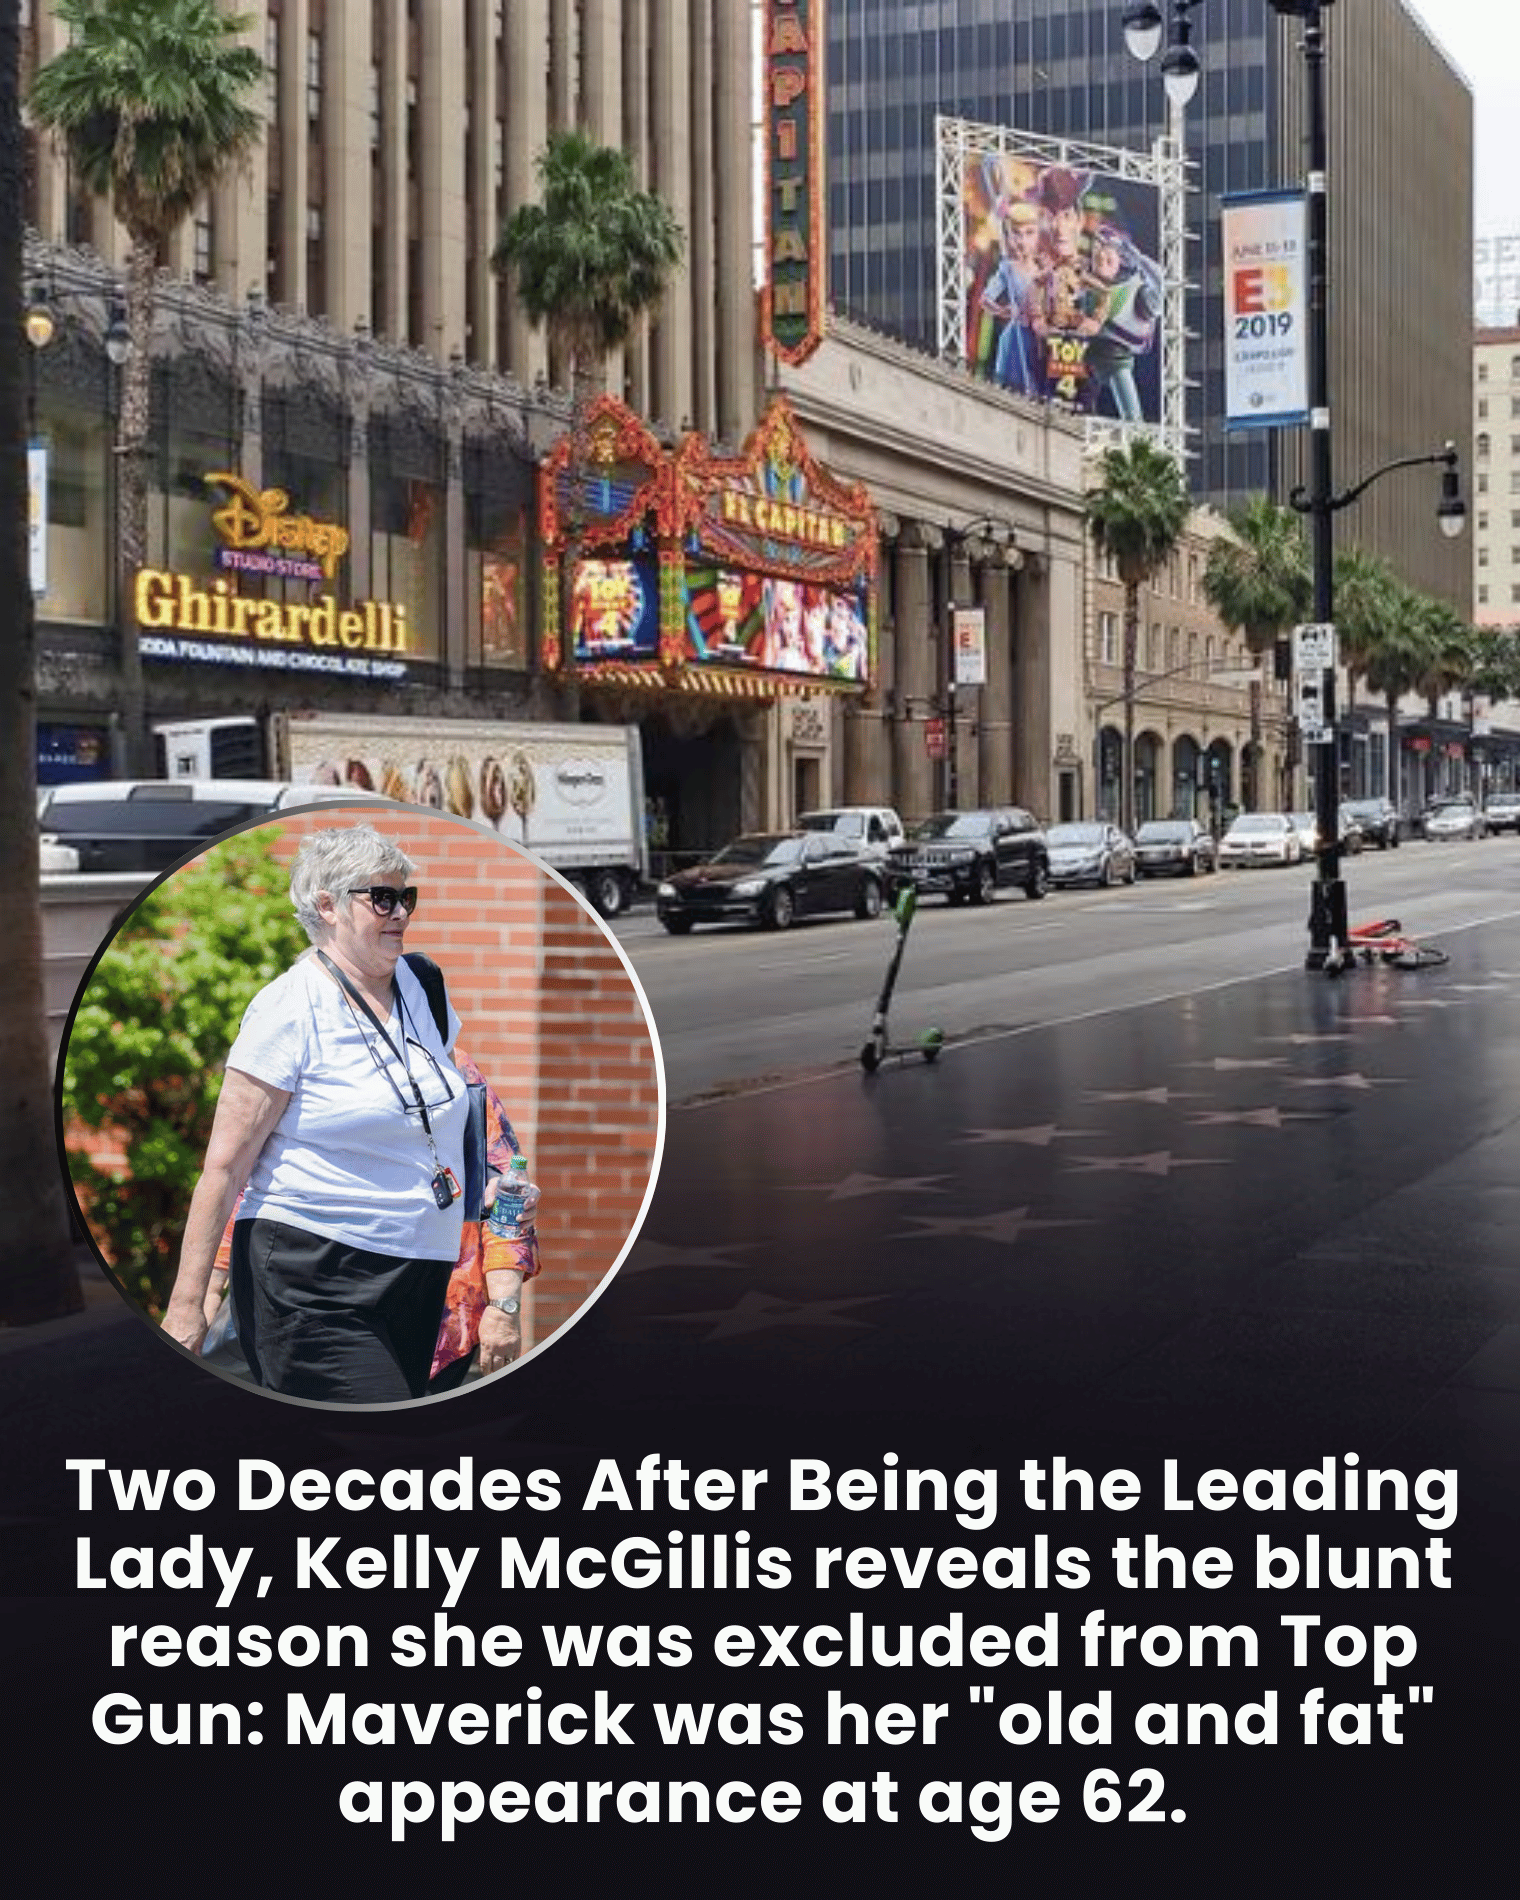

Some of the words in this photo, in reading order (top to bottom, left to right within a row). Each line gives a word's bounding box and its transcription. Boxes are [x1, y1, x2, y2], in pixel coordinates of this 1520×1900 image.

[771, 0, 809, 316] APITAN
[1234, 264, 1293, 315] E3
[1234, 311, 1293, 340] 2019
[1046, 337, 1089, 363] TOY
[1055, 374, 1078, 399] 4
[203, 472, 349, 579] Disney
[754, 499, 847, 547] CAPITAN
[135, 568, 407, 651] Ghirardelli
[178, 640, 254, 666] FOUNTAIN
